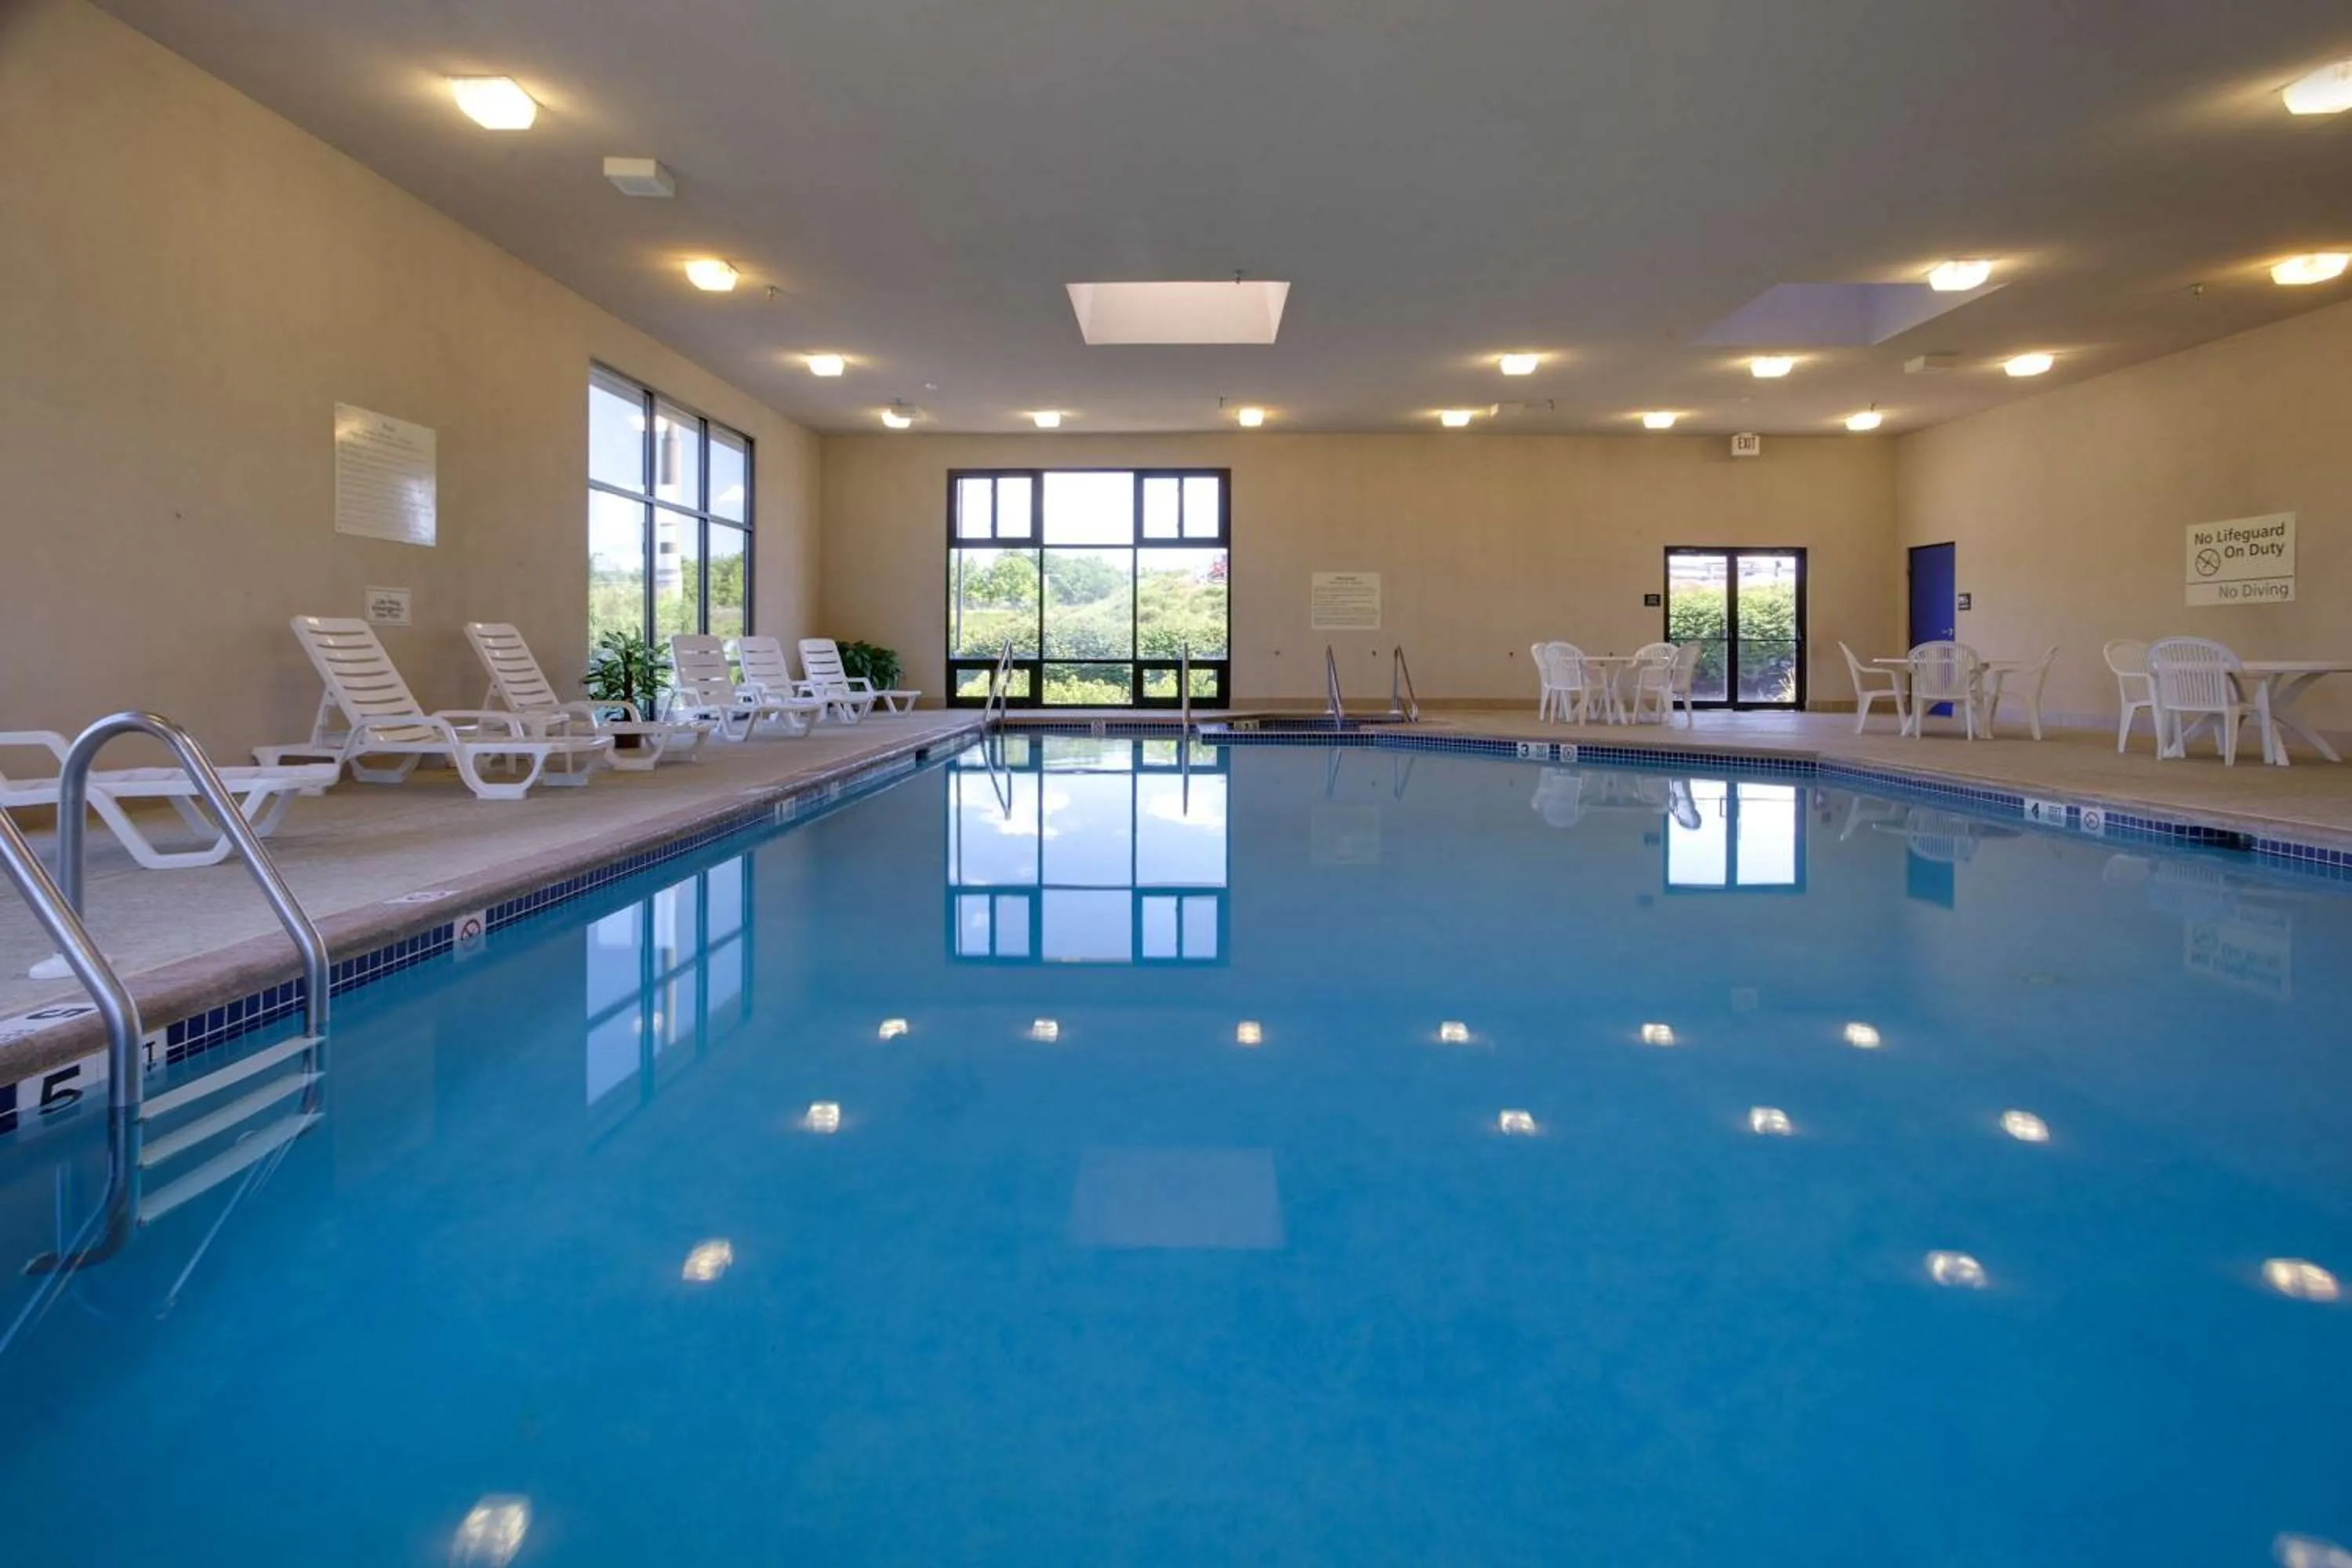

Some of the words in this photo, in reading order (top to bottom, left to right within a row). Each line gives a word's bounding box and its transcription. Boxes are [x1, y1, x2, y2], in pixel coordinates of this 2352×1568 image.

[2194, 532, 2213, 545] No
[2216, 521, 2285, 543] Lifeguard
[2224, 545, 2245, 558] On
[2249, 542, 2285, 557] Duty
[2219, 586, 2238, 598] No
[2242, 583, 2288, 599] Diving
[38, 1064, 83, 1115] 5
